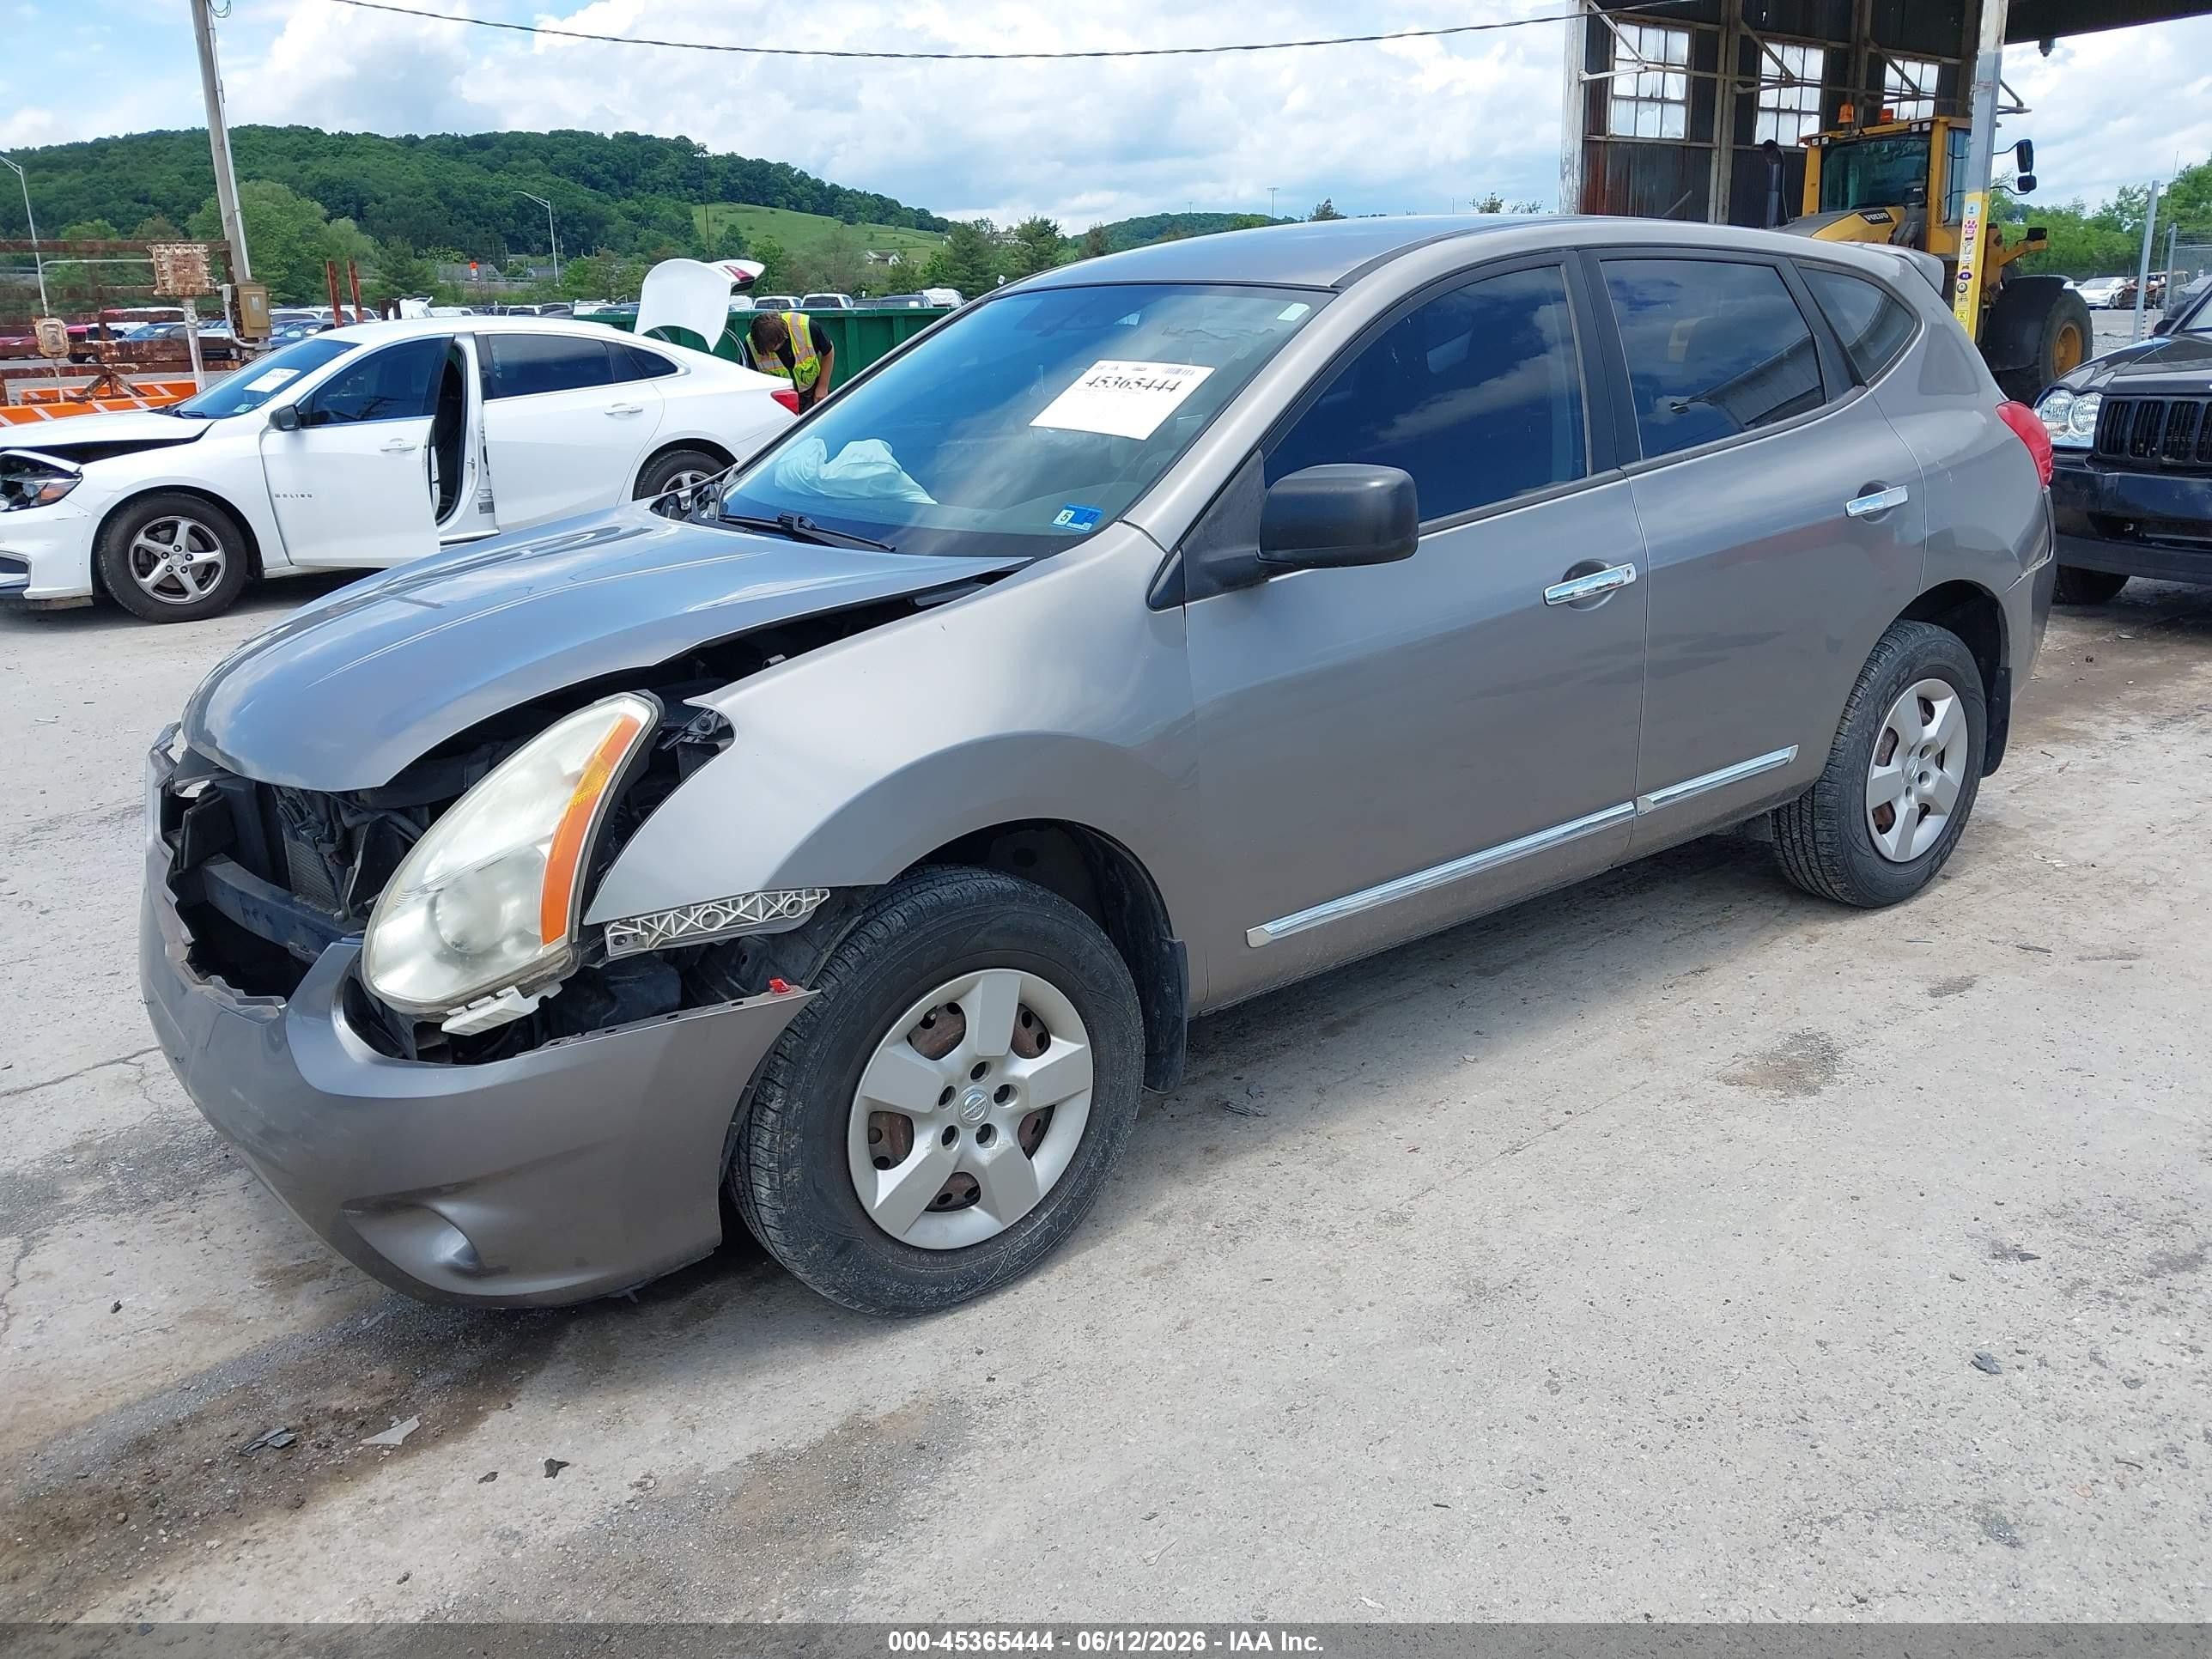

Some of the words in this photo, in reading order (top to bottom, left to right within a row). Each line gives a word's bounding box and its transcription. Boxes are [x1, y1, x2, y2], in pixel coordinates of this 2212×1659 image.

[1863, 212, 1889, 221] VOLVO
[1085, 376, 1182, 392] 45365444
[1060, 512, 1072, 521] 5
